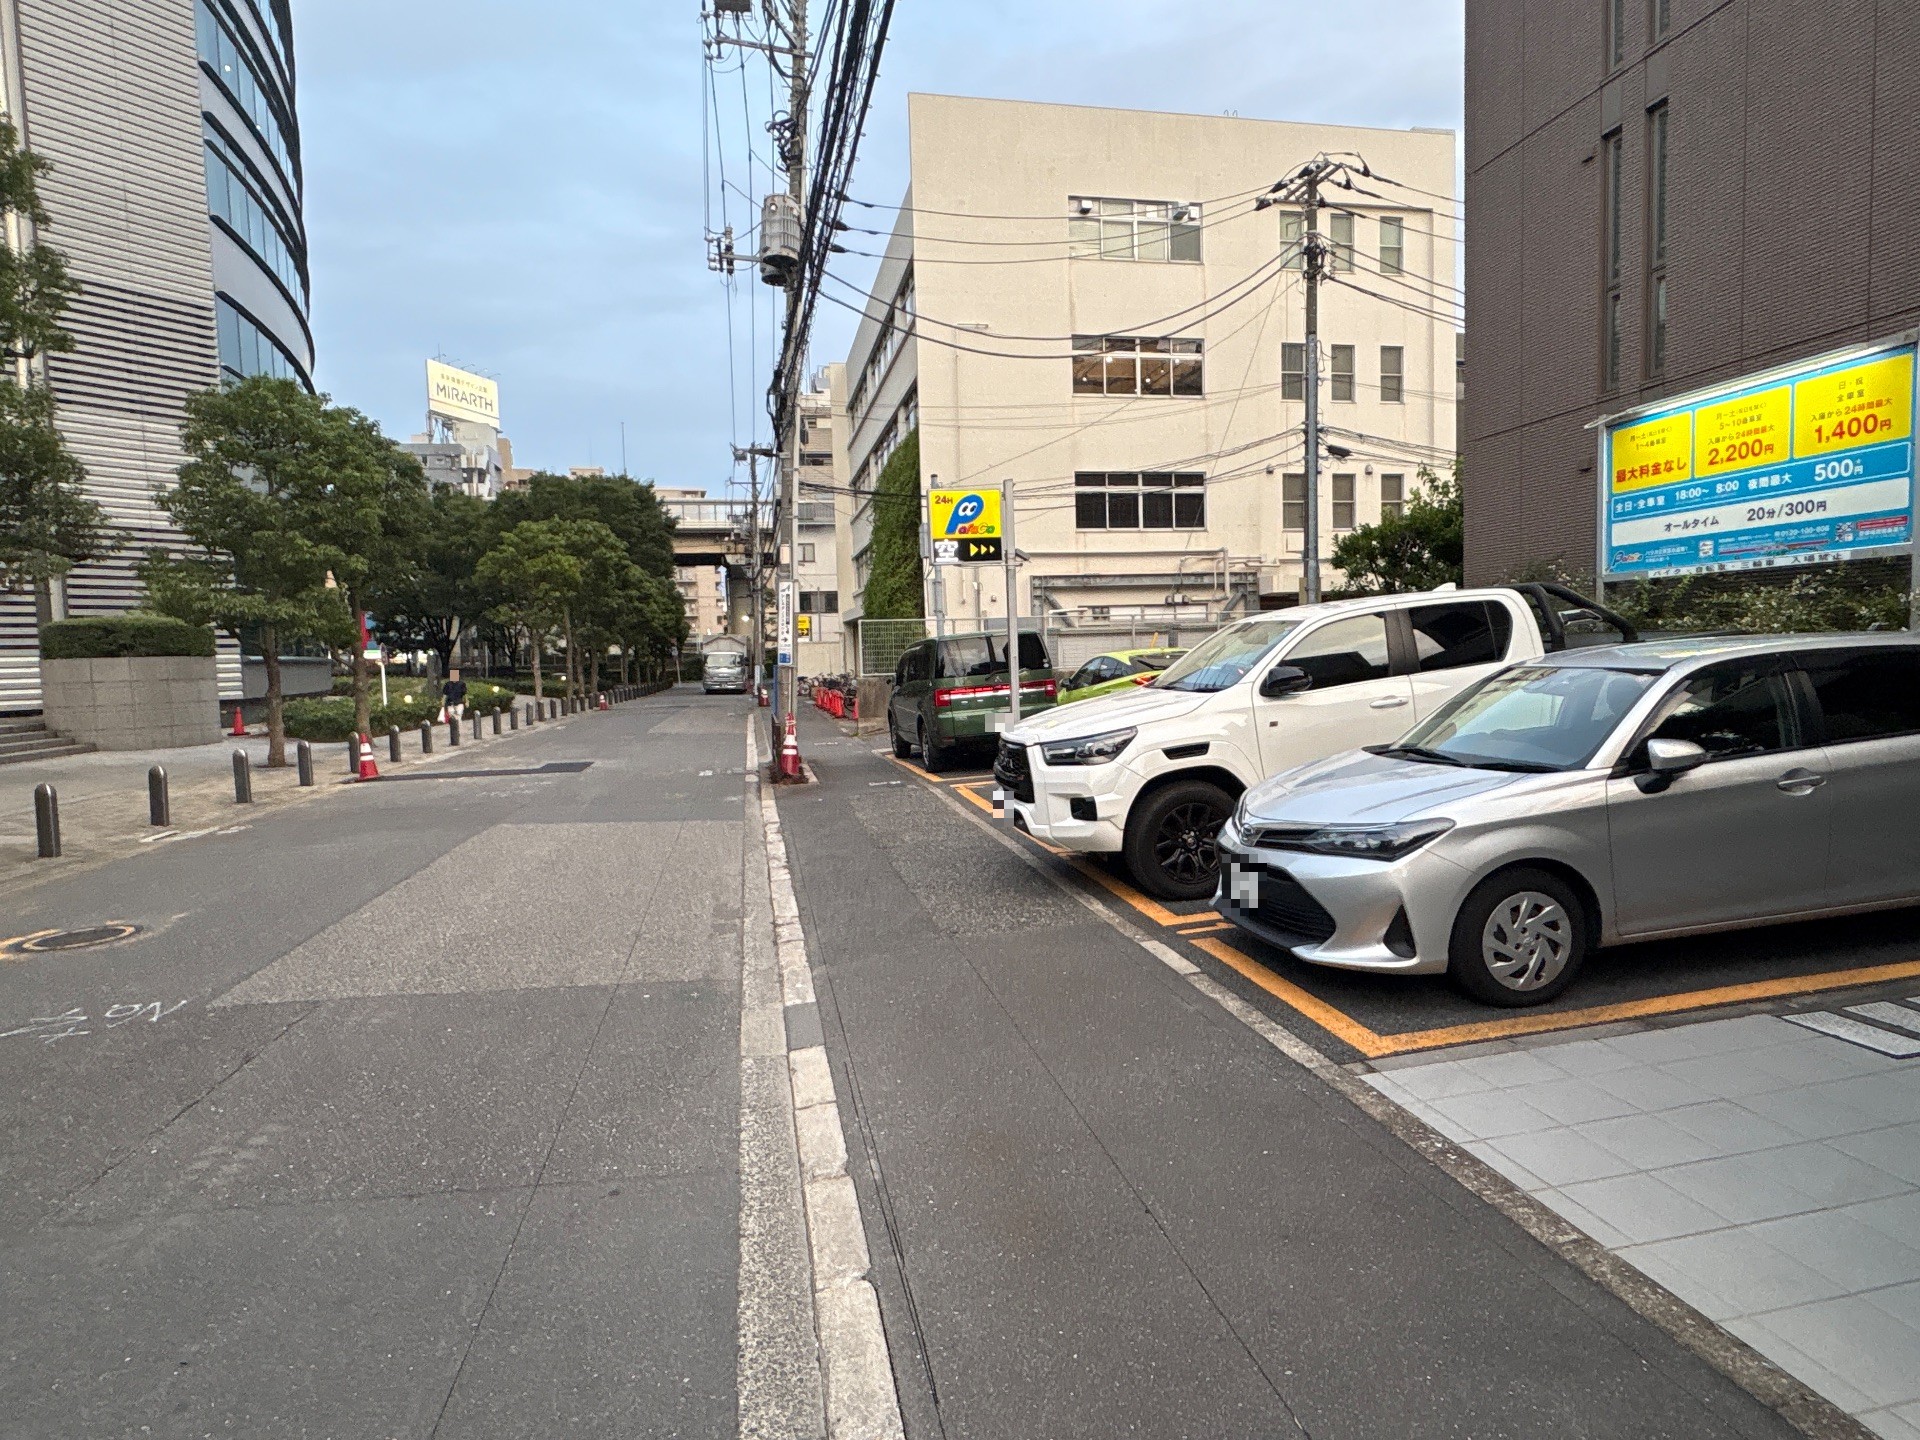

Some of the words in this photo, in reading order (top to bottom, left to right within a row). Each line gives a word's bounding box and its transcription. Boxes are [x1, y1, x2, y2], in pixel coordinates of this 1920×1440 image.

[436, 382, 494, 412] MIRARTH
[1814, 413, 1892, 444] 1,400円
[1707, 438, 1774, 466] 2,200円
[1616, 457, 1687, 483] 最大料金なし
[1715, 480, 1740, 494] 8:00
[1747, 472, 1793, 491] 夜間最大
[935, 494, 953, 505] 24H
[1664, 516, 1720, 533] オールタイム
[1746, 499, 1827, 522] 20分/300円
[935, 539, 959, 562] 空
